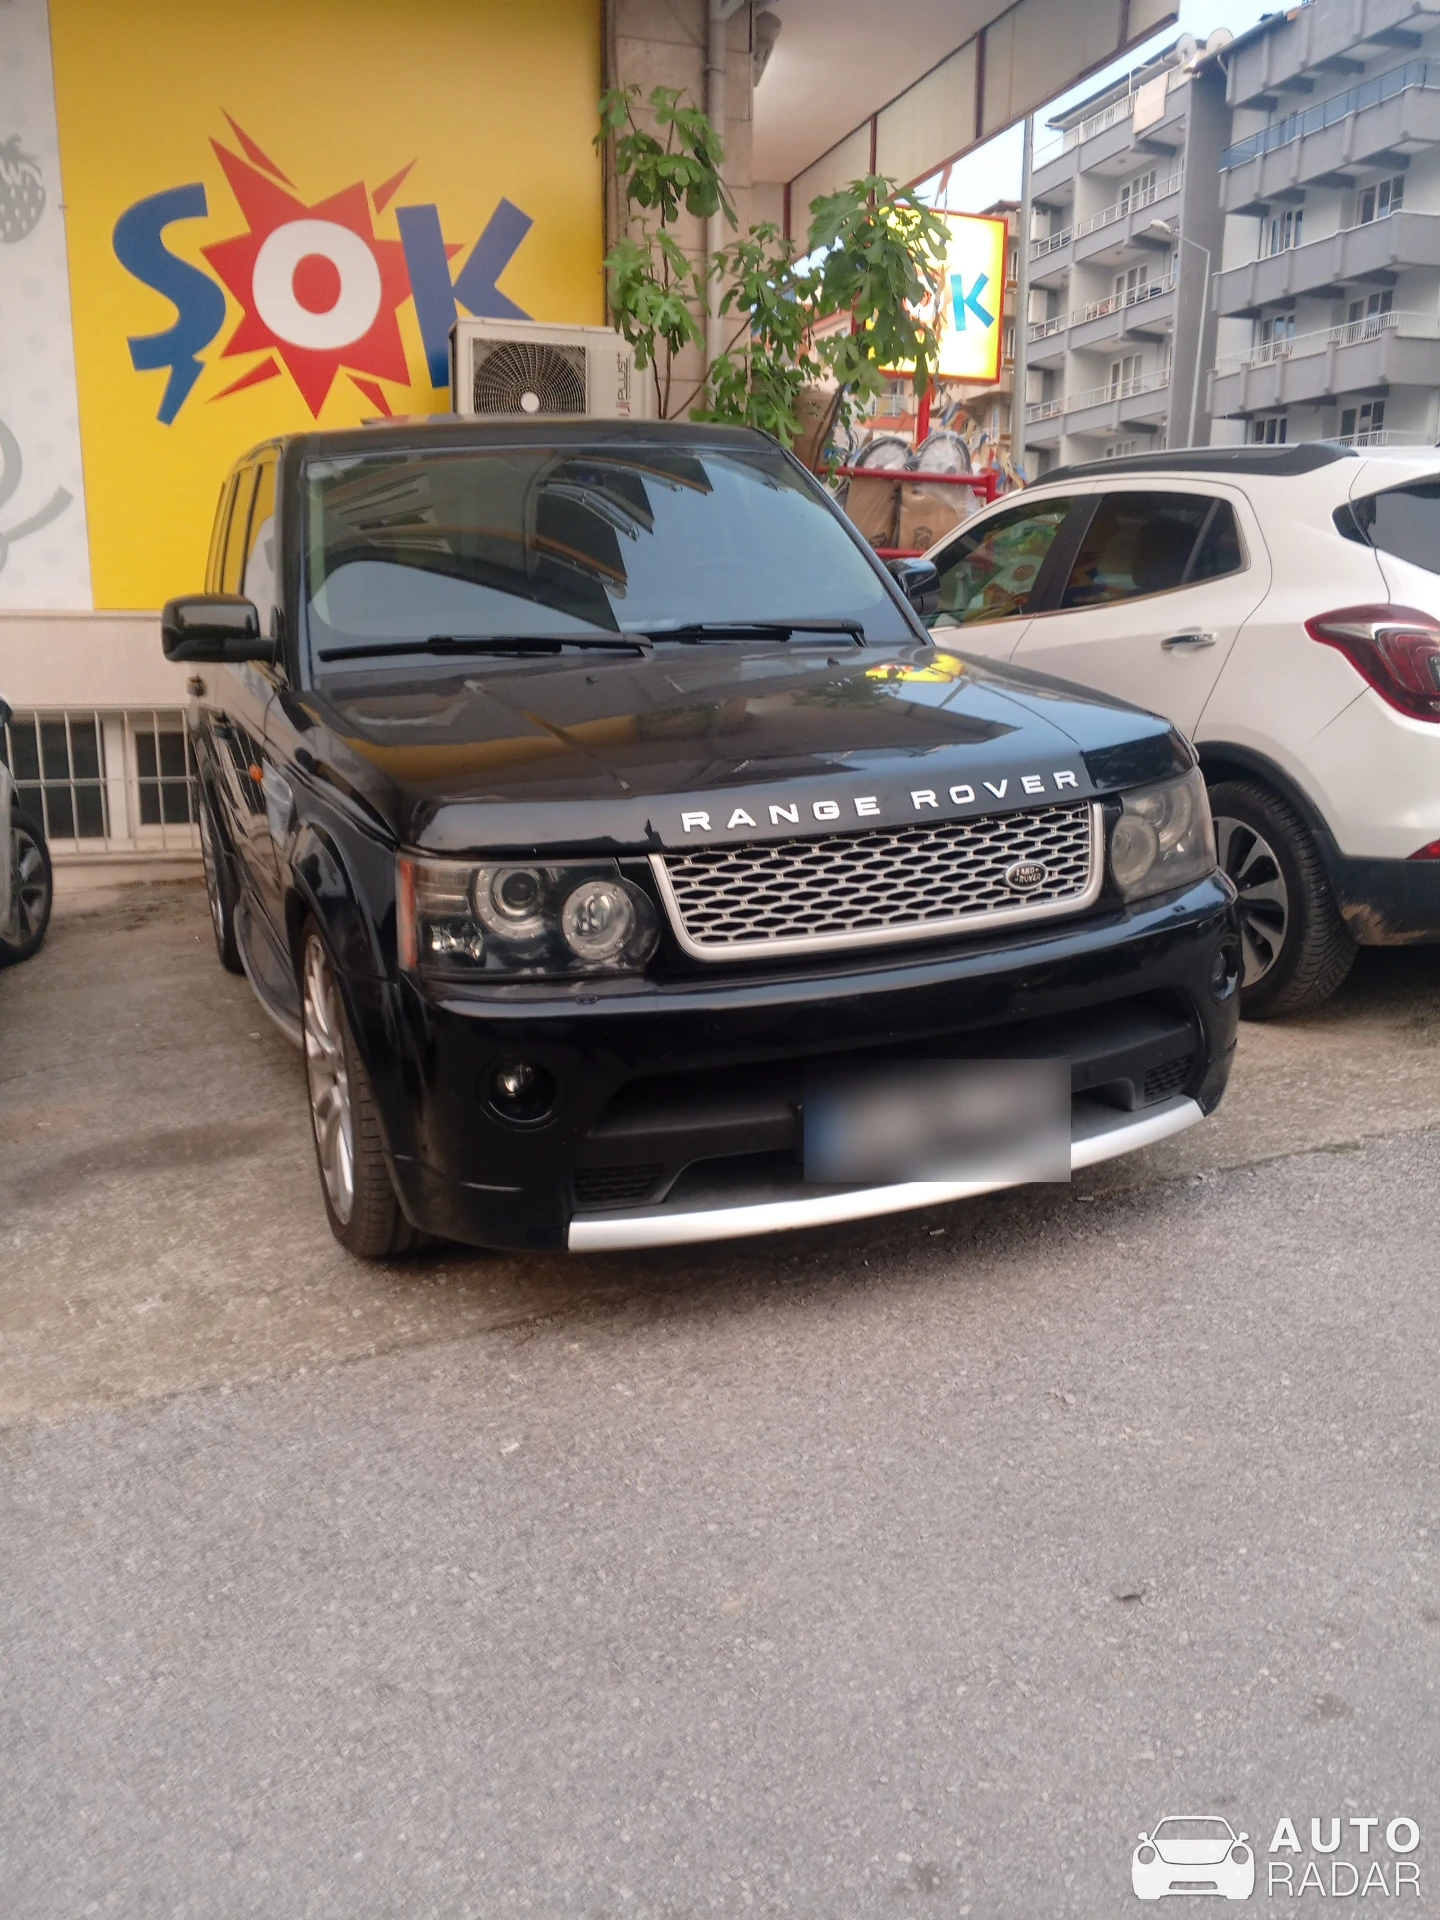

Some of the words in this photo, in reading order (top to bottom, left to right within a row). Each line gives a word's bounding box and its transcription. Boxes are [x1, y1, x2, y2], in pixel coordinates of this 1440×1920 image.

[112, 182, 534, 426] ŞOK
[682, 795, 881, 832] RANGE
[911, 770, 1079, 809] ROVER
[1016, 866, 1035, 877] LAND
[1019, 873, 1042, 883] ROVER
